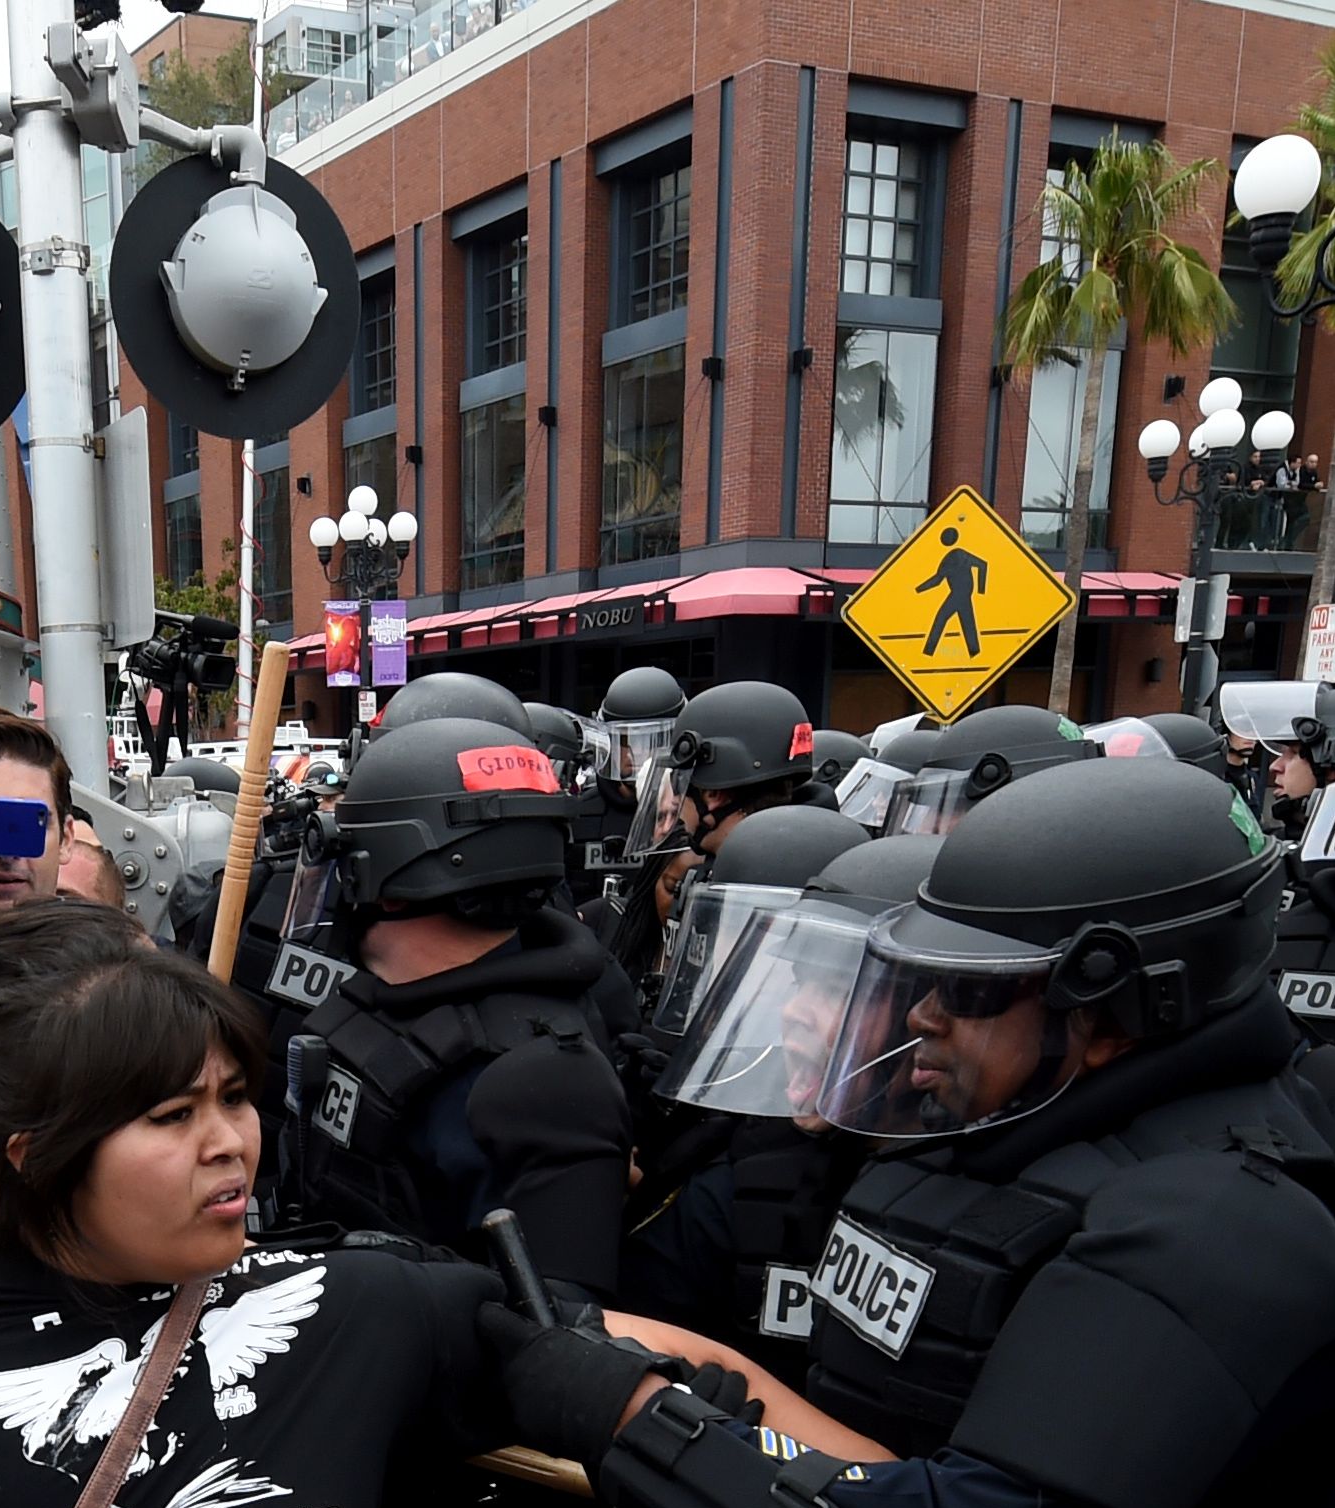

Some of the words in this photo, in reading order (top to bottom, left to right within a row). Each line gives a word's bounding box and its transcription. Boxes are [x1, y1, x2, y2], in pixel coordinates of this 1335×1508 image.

[581, 606, 636, 630] NOBU
[1312, 608, 1328, 628] NO
[1320, 647, 1334, 659] ANY
[1318, 661, 1333, 673] TIME
[817, 1232, 918, 1335] POLICE
